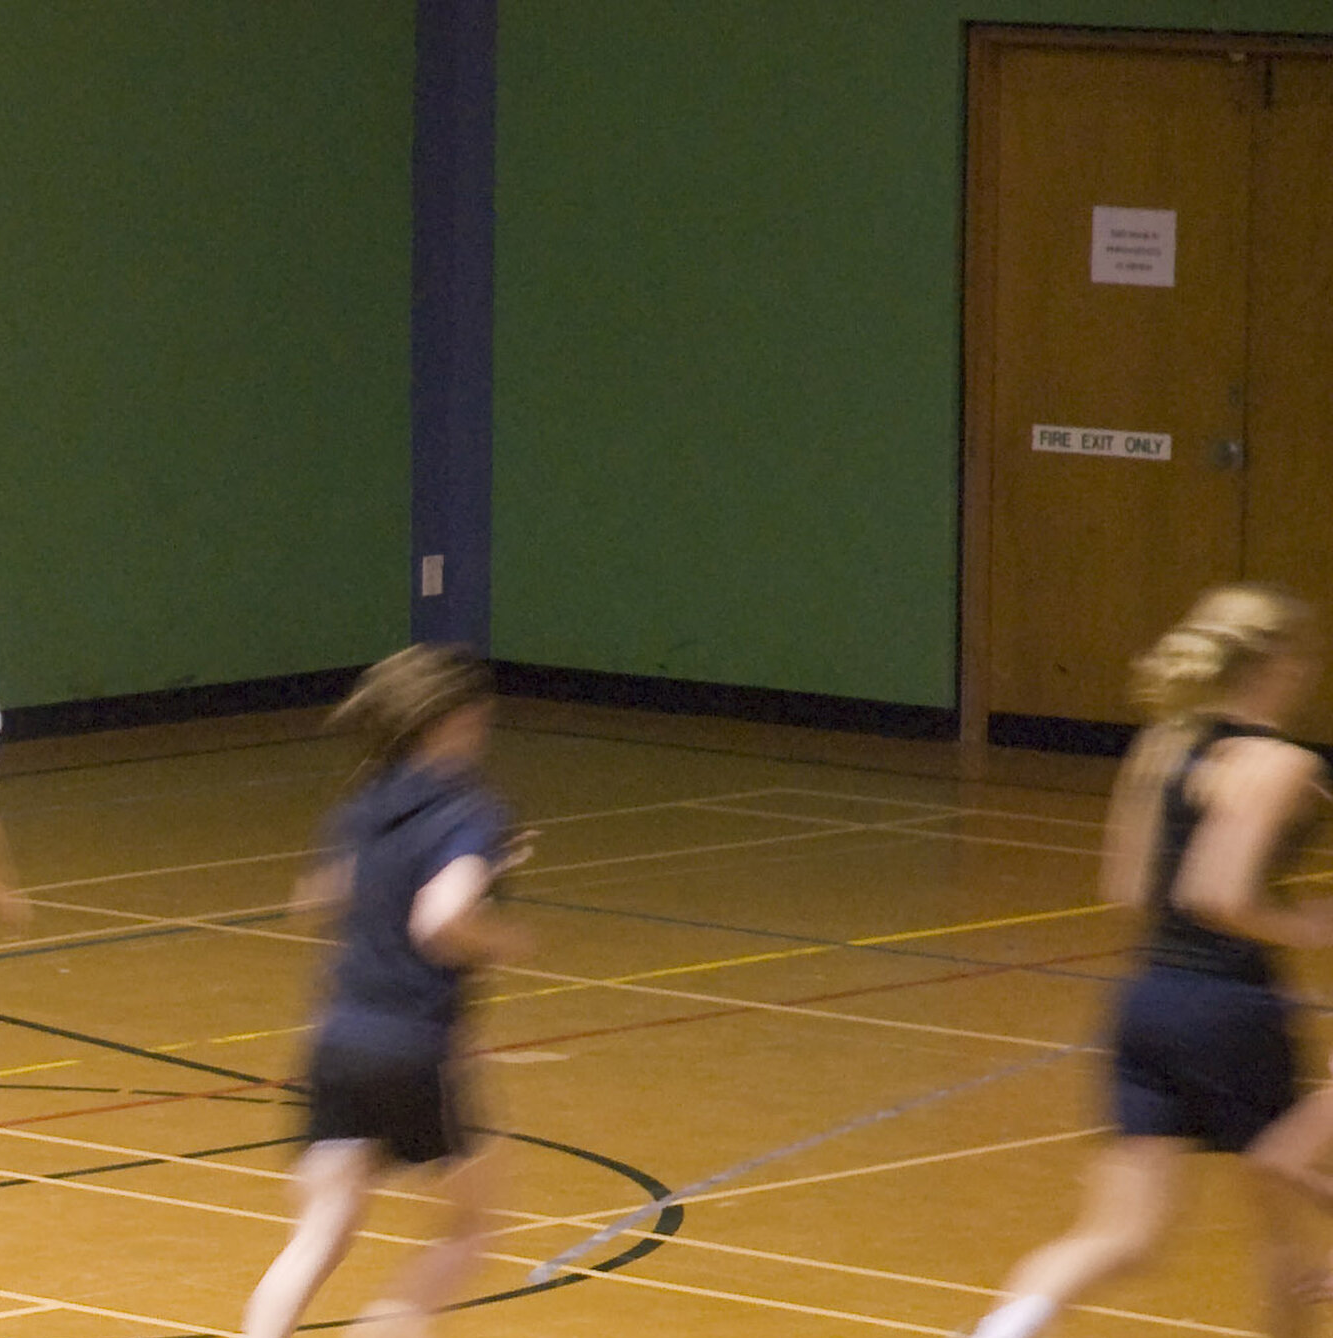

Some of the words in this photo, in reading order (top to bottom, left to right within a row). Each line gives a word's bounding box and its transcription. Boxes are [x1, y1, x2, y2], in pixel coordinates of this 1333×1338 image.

[1039, 431, 1071, 448] FIRE
[1081, 433, 1114, 451] EXIT
[1124, 436, 1163, 455] ONLY
